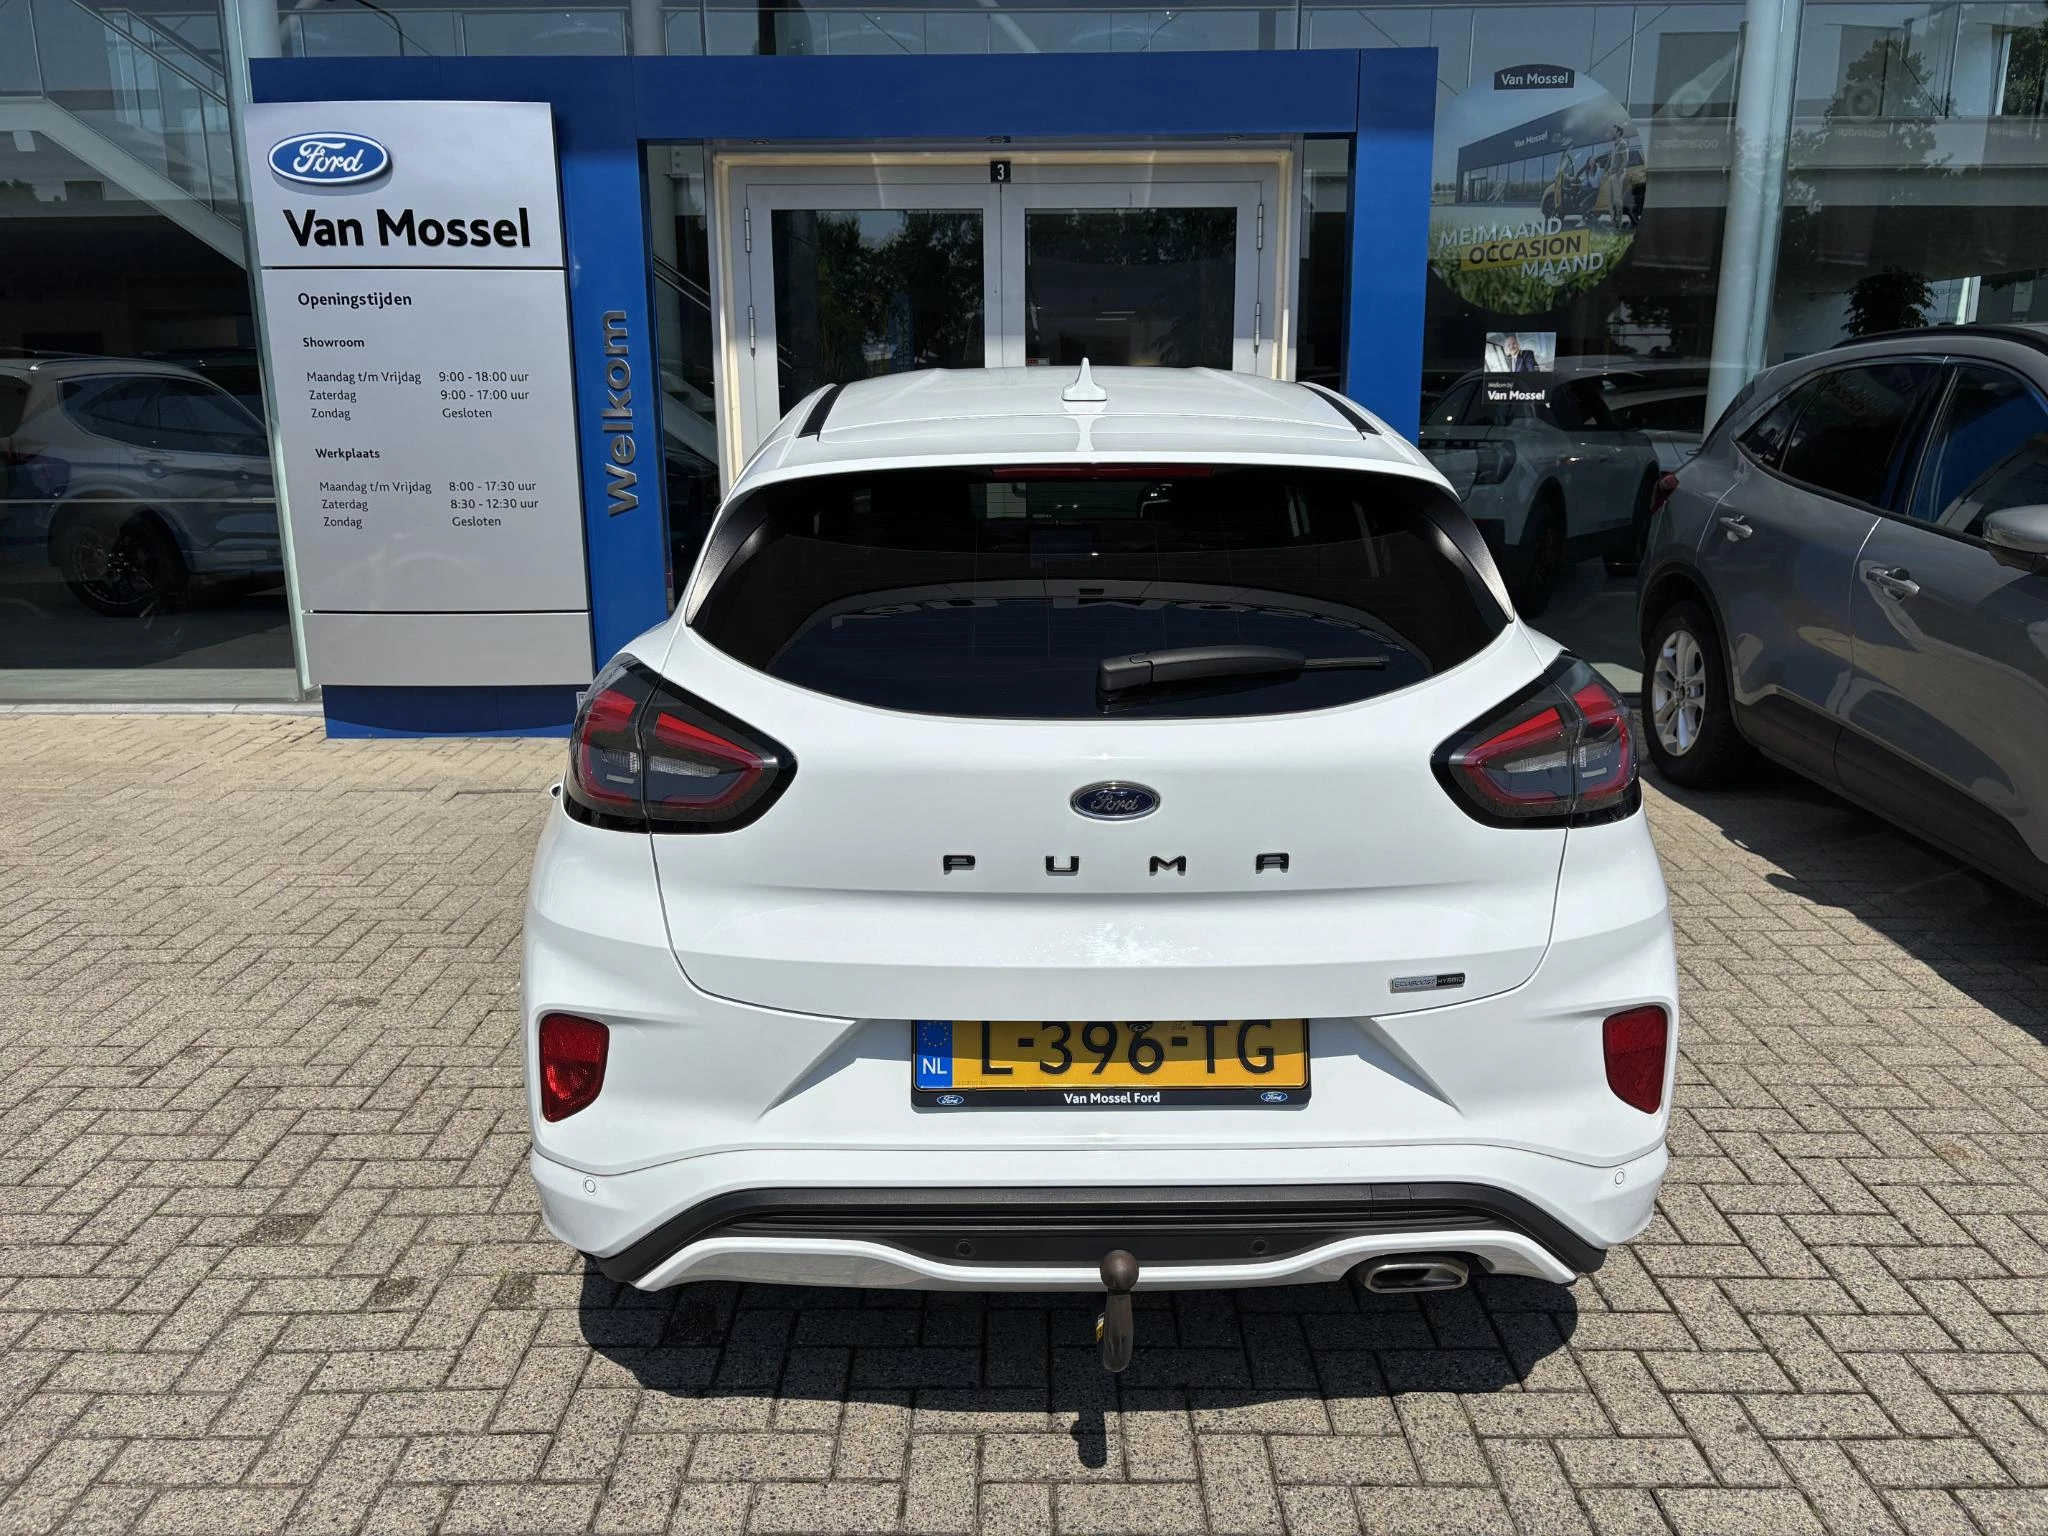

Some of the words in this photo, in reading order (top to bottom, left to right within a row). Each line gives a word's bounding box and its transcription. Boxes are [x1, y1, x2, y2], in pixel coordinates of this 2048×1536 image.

[1501, 74, 1523, 86] Van
[1527, 72, 1569, 85] Mossel
[293, 141, 364, 173] Ford
[997, 163, 1005, 180] 3
[283, 209, 364, 247] Van
[377, 208, 530, 248] Mossel
[1468, 235, 1581, 265] OCCASION
[1521, 252, 1604, 279] MAAND
[298, 292, 411, 309] Openingstijden
[303, 337, 364, 347] Showroom
[307, 371, 355, 384] Maandag
[358, 372, 378, 382] t/m
[381, 371, 421, 384] Vrijdag
[439, 372, 464, 382] 9:00
[475, 372, 506, 381] 18:00
[309, 390, 356, 403] Zaterdag
[441, 390, 466, 400] 9:00
[477, 390, 507, 399] 17:00
[1488, 391, 1507, 400] Van
[1509, 390, 1545, 400] Mossel
[311, 408, 351, 421] Zondag
[443, 408, 492, 418] Gesloten
[602, 310, 639, 517] Welkom
[315, 448, 380, 461] Werkplaats
[320, 481, 367, 494] Maandag
[370, 481, 389, 491] t/m
[392, 482, 432, 494] Vrijdag
[449, 482, 474, 491] 8:00
[485, 481, 514, 491] 17:30
[322, 499, 368, 512] Zaterdag
[451, 499, 475, 509] 8:30
[486, 499, 516, 508] 12:30
[324, 517, 362, 529] Zondag
[452, 516, 501, 526] Gesloten
[943, 853, 1290, 876] PUMA
[1437, 976, 1464, 984] HYBRID
[981, 1020, 1275, 1075] L-396-TG
[922, 1058, 948, 1075] NL
[1064, 1093, 1087, 1104] Van
[1090, 1092, 1131, 1104] Mossel
[1134, 1092, 1161, 1103] Ford
